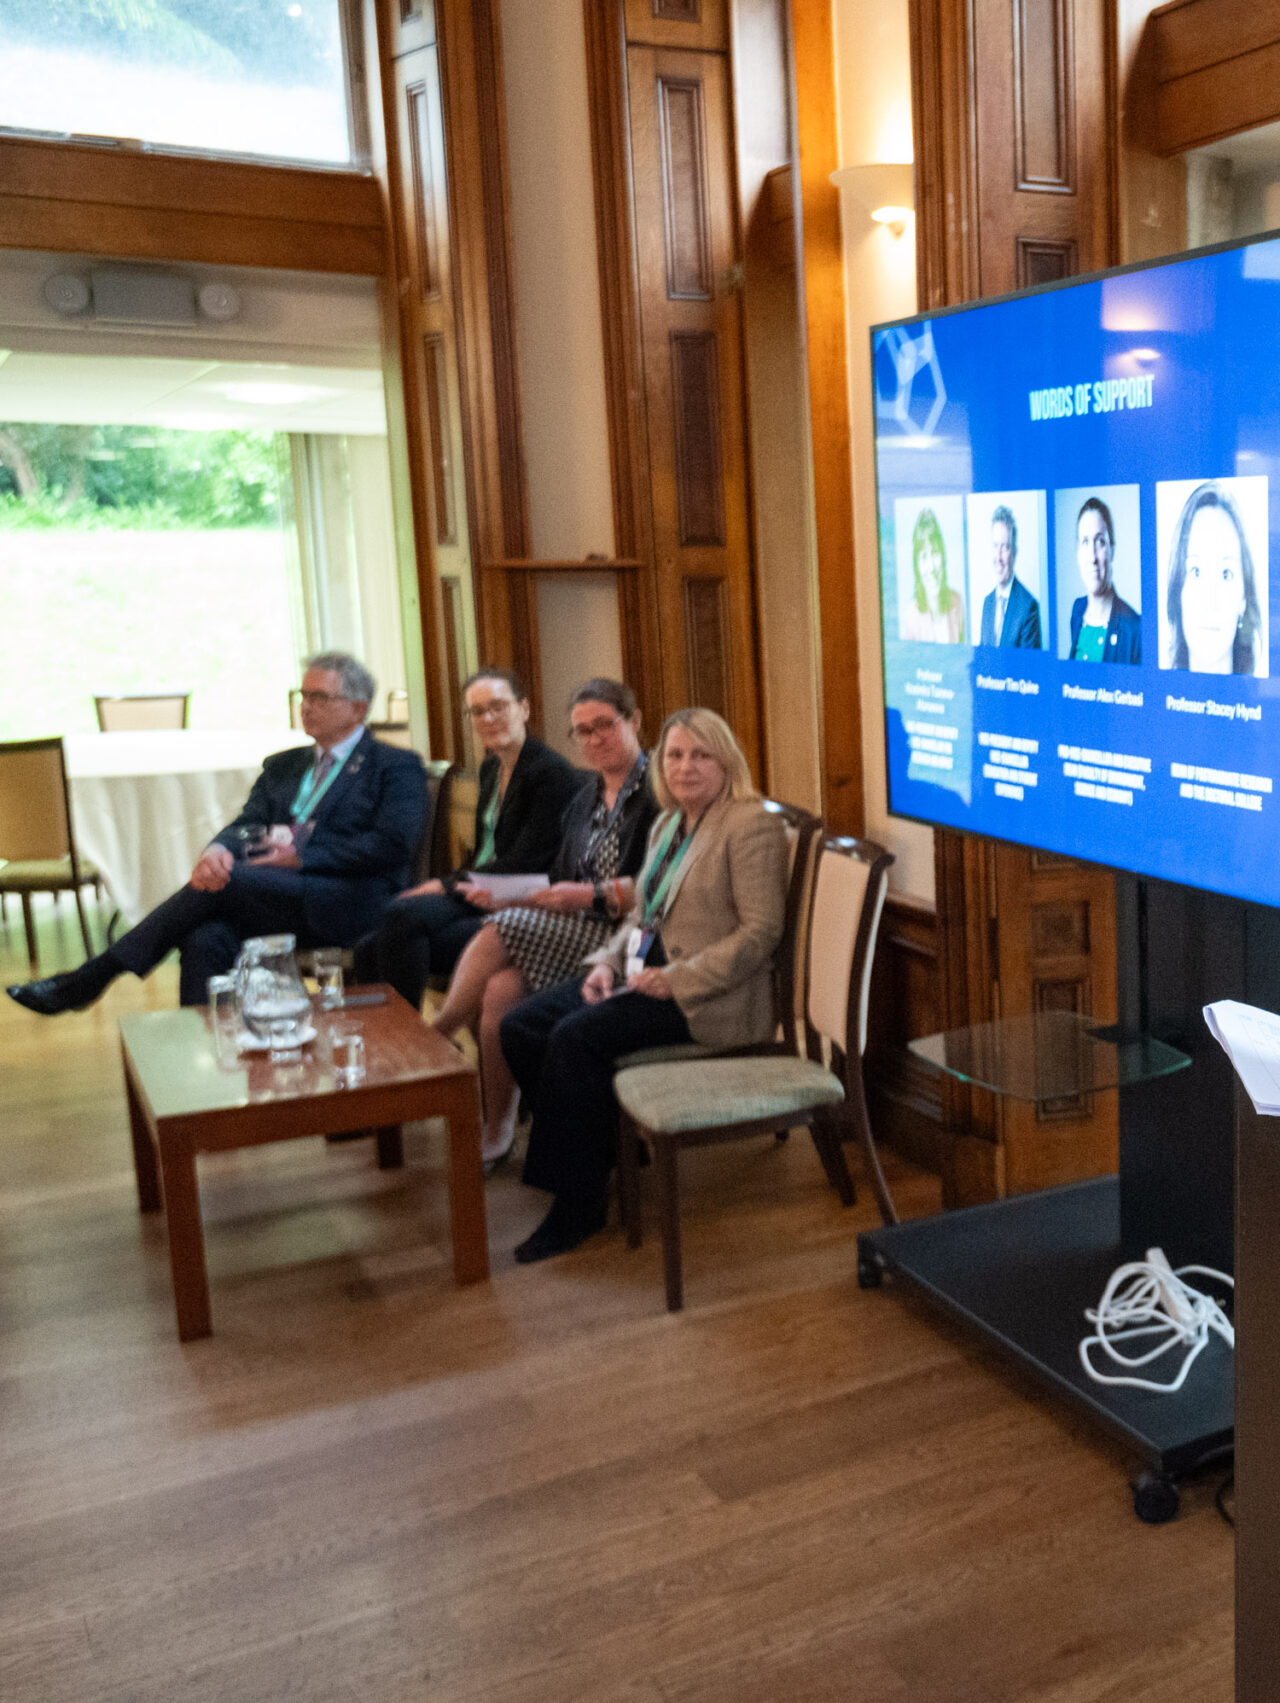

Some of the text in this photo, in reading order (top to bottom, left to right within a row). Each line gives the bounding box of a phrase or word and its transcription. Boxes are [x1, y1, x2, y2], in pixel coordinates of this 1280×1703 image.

[1029, 374, 1155, 421] WORDS OF SUPPORT
[1062, 683, 1097, 701] Professor
[1166, 695, 1262, 722] Professor Stacey Hynd
